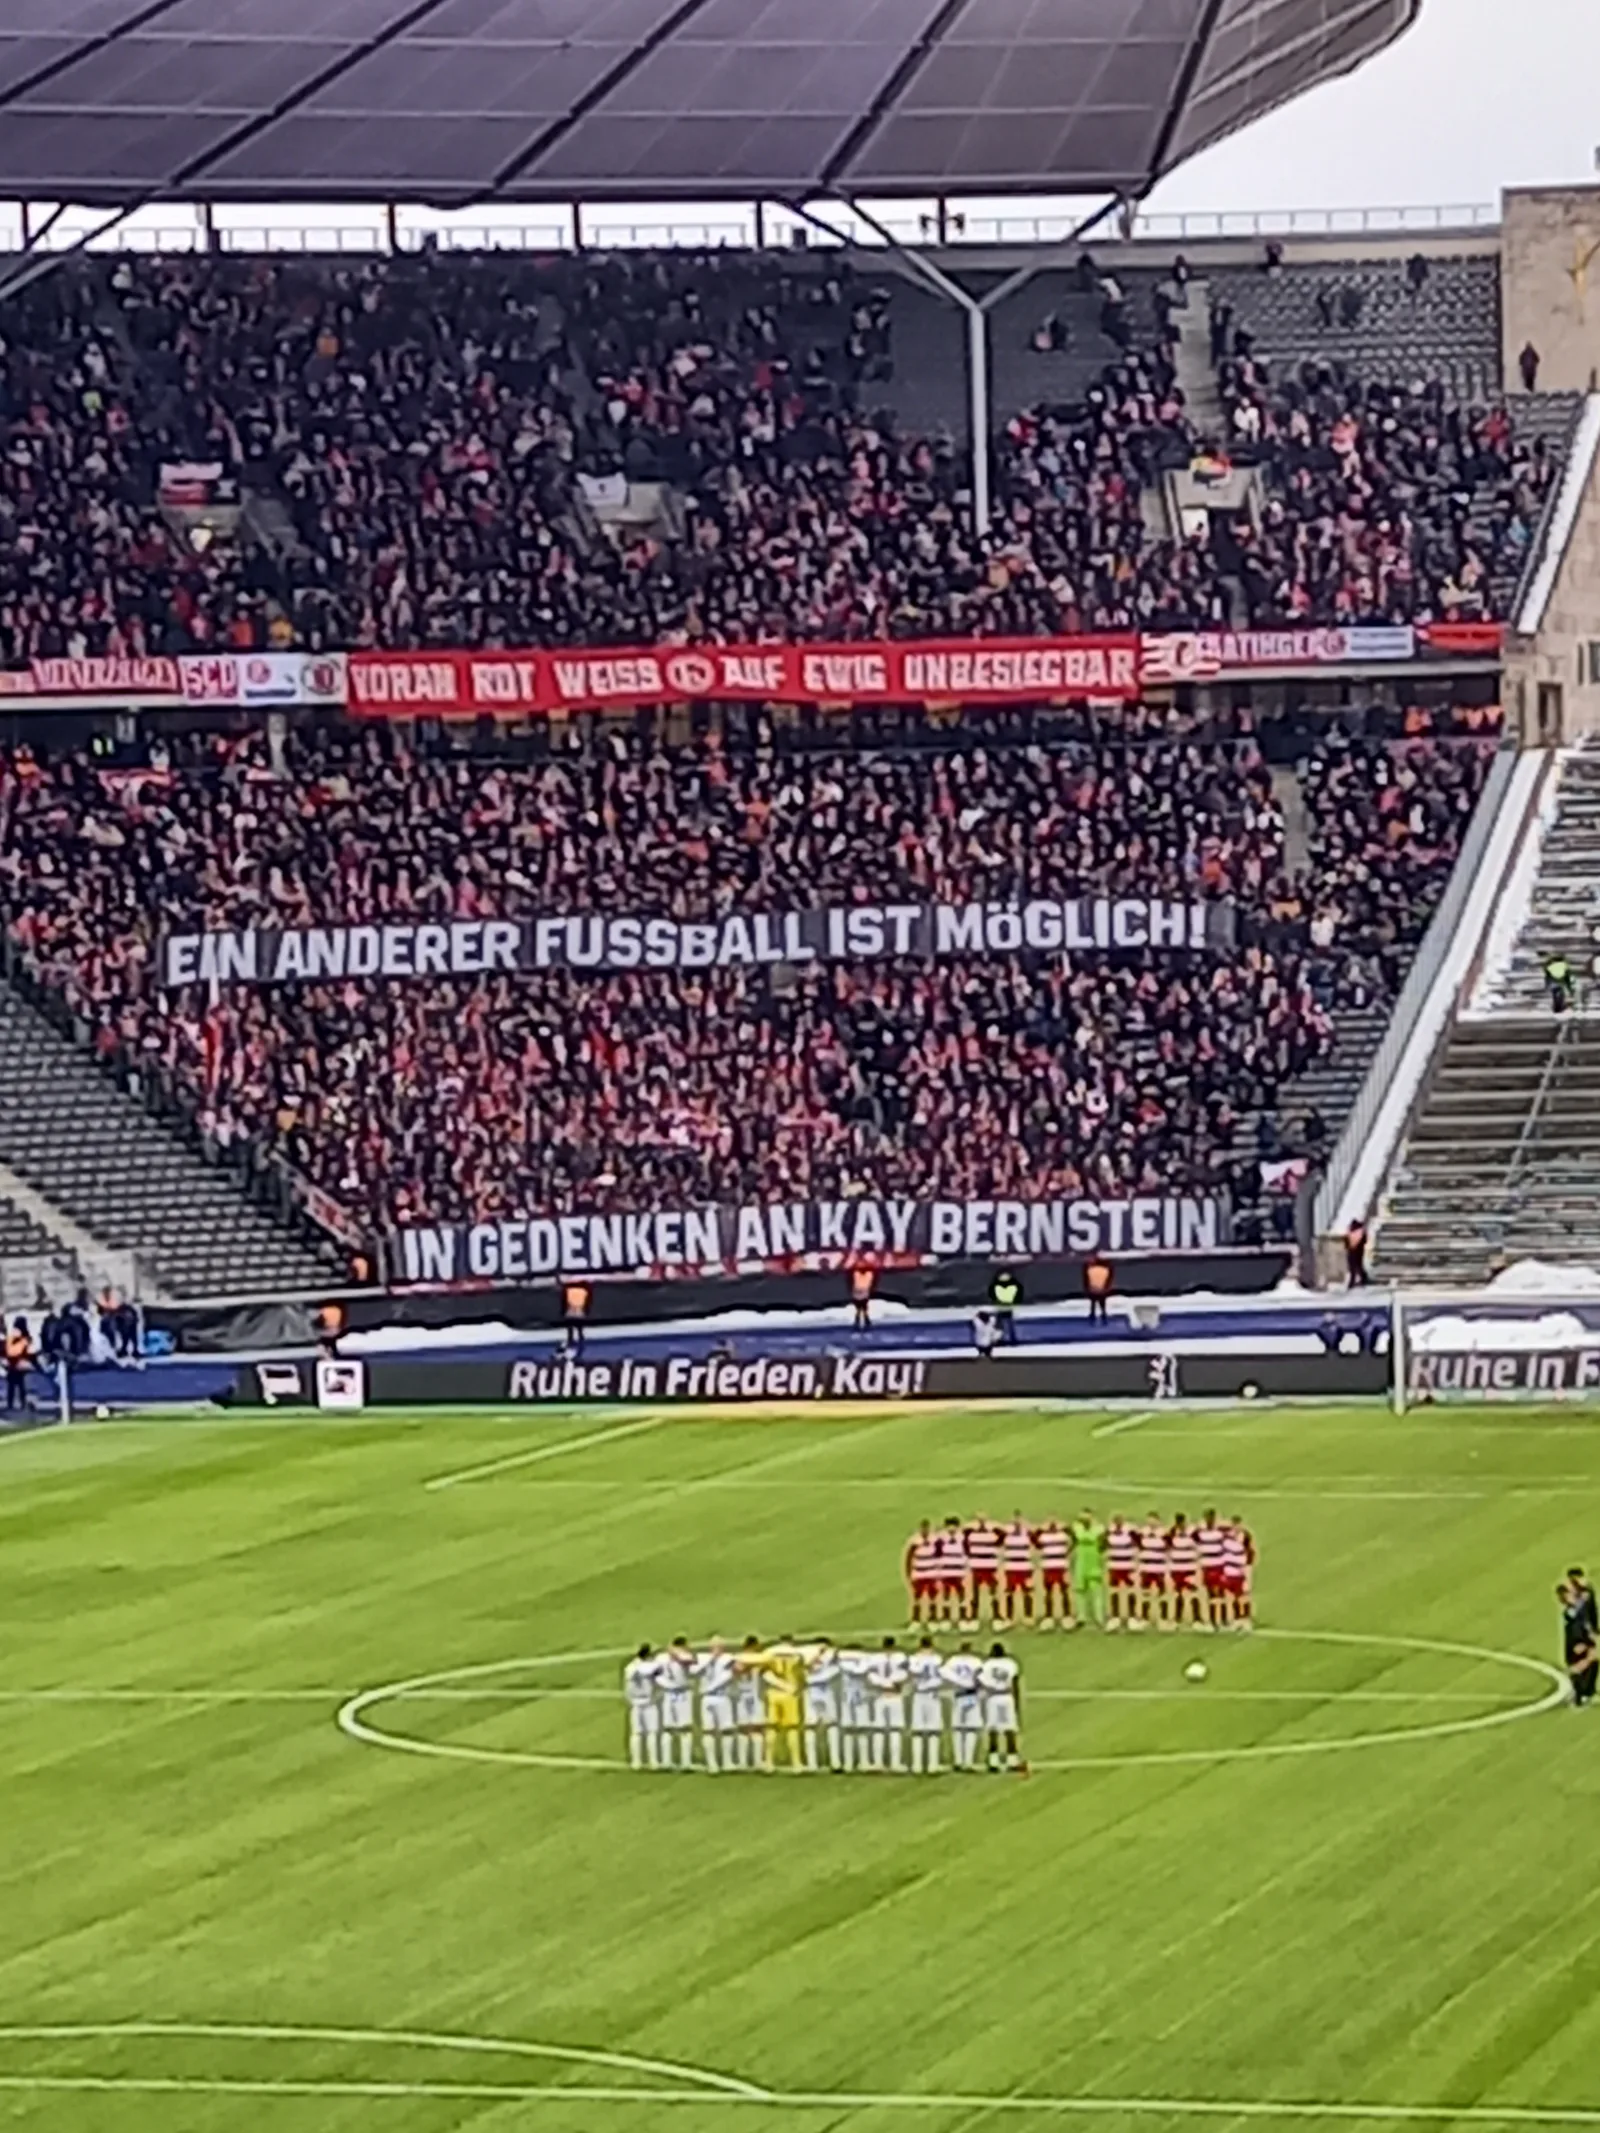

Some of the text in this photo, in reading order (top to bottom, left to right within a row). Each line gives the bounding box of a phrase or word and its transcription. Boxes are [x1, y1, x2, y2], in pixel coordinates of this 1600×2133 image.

[350, 662, 457, 702] VORAN
[471, 661, 535, 702] ROT
[553, 656, 664, 701] WEISS
[718, 655, 787, 689] AUF
[804, 653, 886, 693] EWIG
[904, 649, 1137, 691] UNBESIEGBAR
[168, 930, 256, 986] EIN
[274, 921, 521, 980] ANDERER
[535, 911, 815, 967] FUSSBALL
[828, 904, 922, 957] IST
[402, 1199, 1217, 1280] IN GEDENKEN AN KAY BERNSTEIN
[509, 1360, 611, 1399] Ruhe
[833, 1357, 926, 1399] Kay!
[1408, 1353, 1518, 1389] Ruhe
